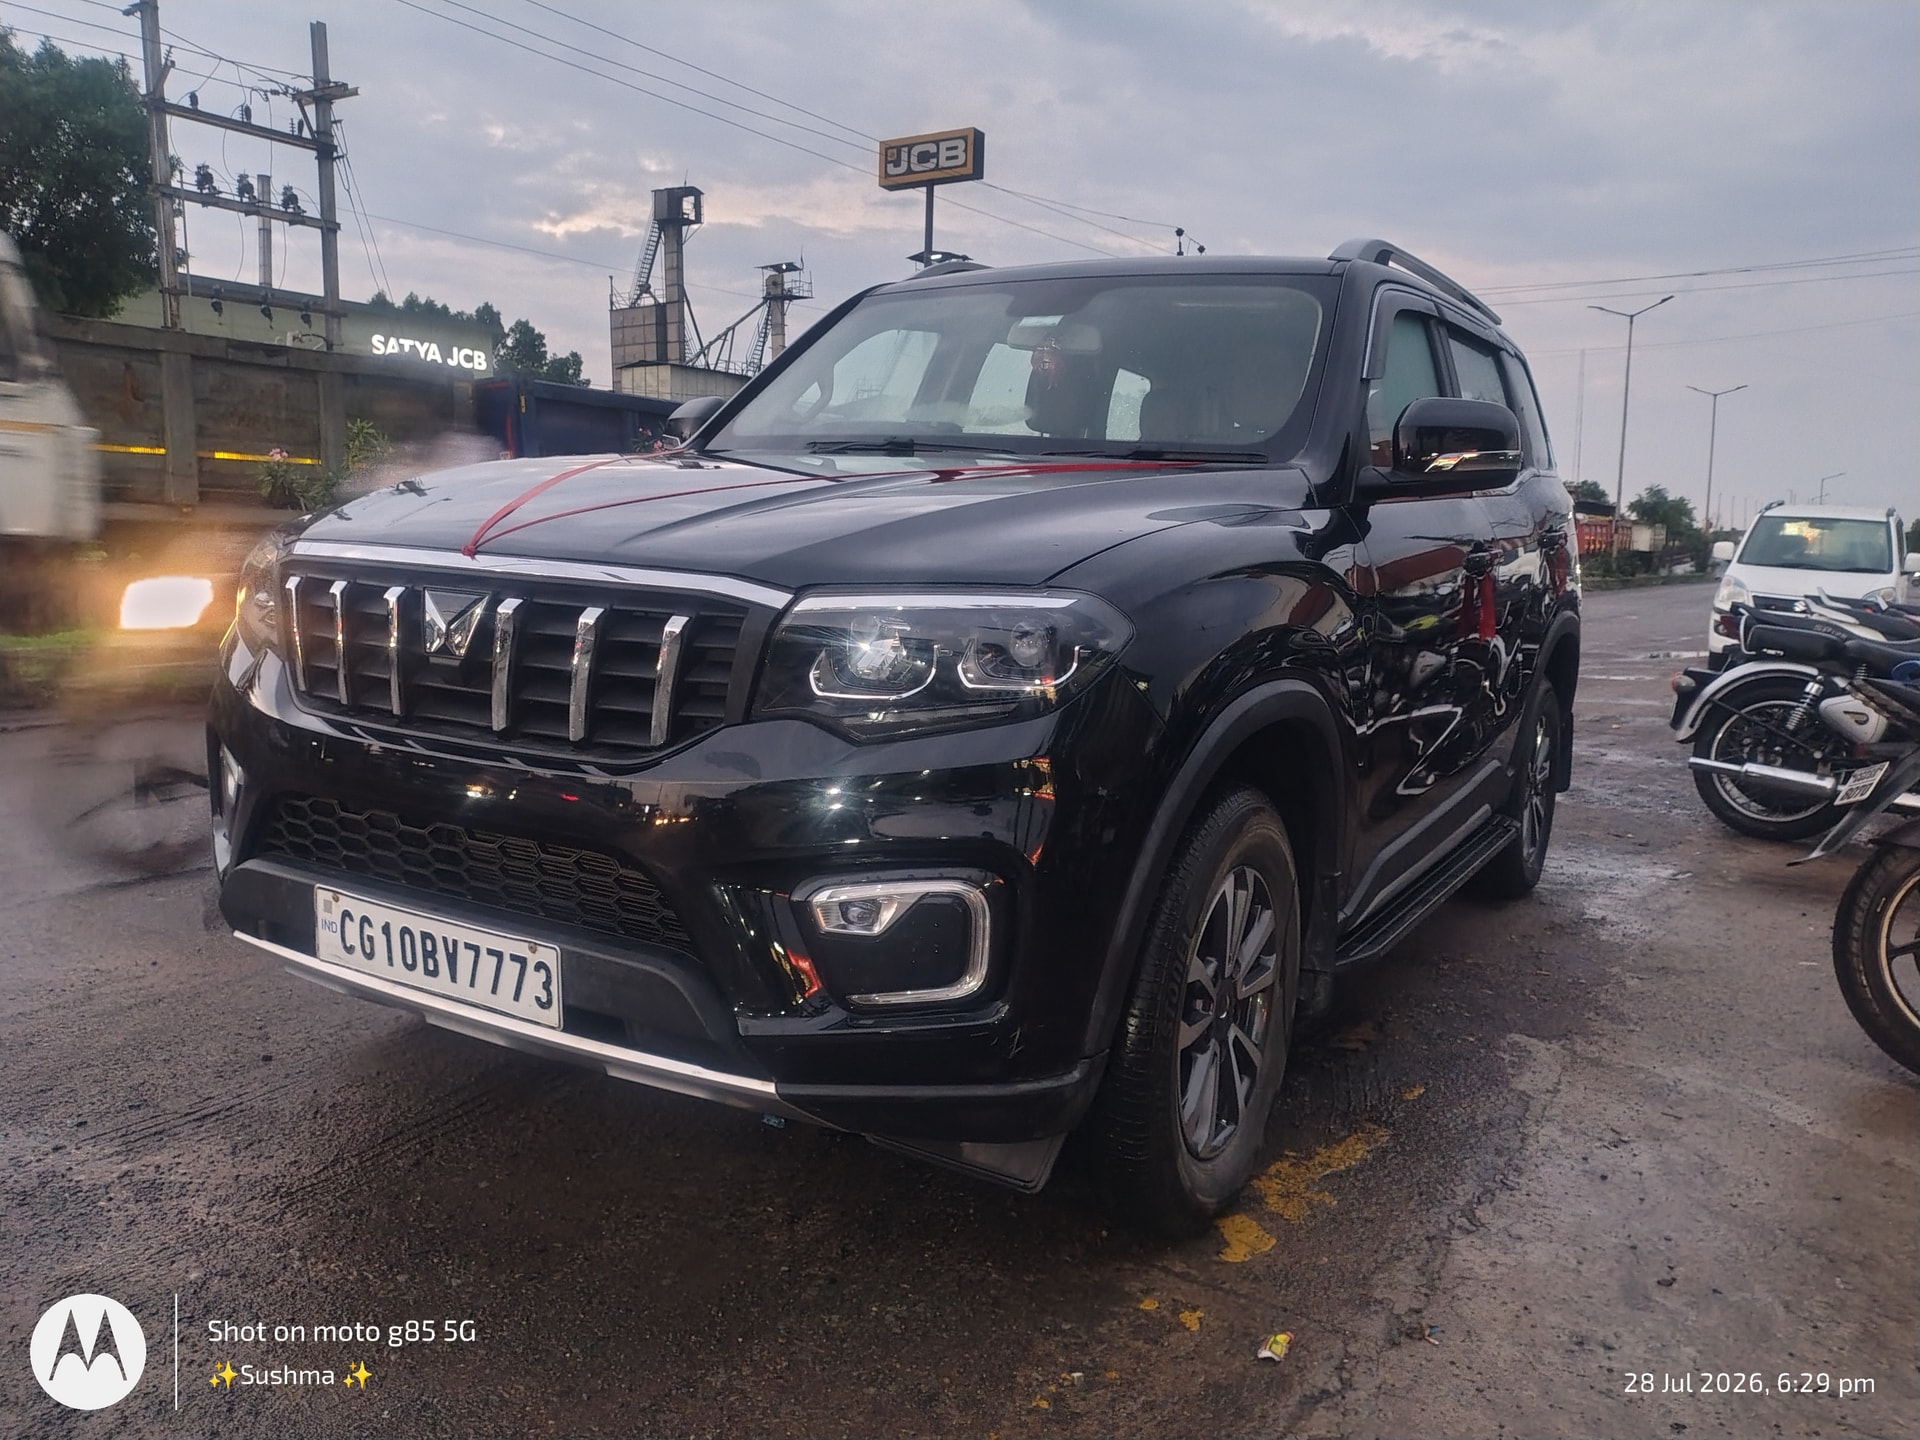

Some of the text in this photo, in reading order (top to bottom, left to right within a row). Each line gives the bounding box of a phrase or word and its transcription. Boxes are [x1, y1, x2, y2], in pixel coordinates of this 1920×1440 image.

[886, 138, 967, 176] JCB
[371, 334, 488, 371] SATYA JCB
[320, 918, 338, 934] IND
[340, 909, 553, 1010] CG10BV7773
